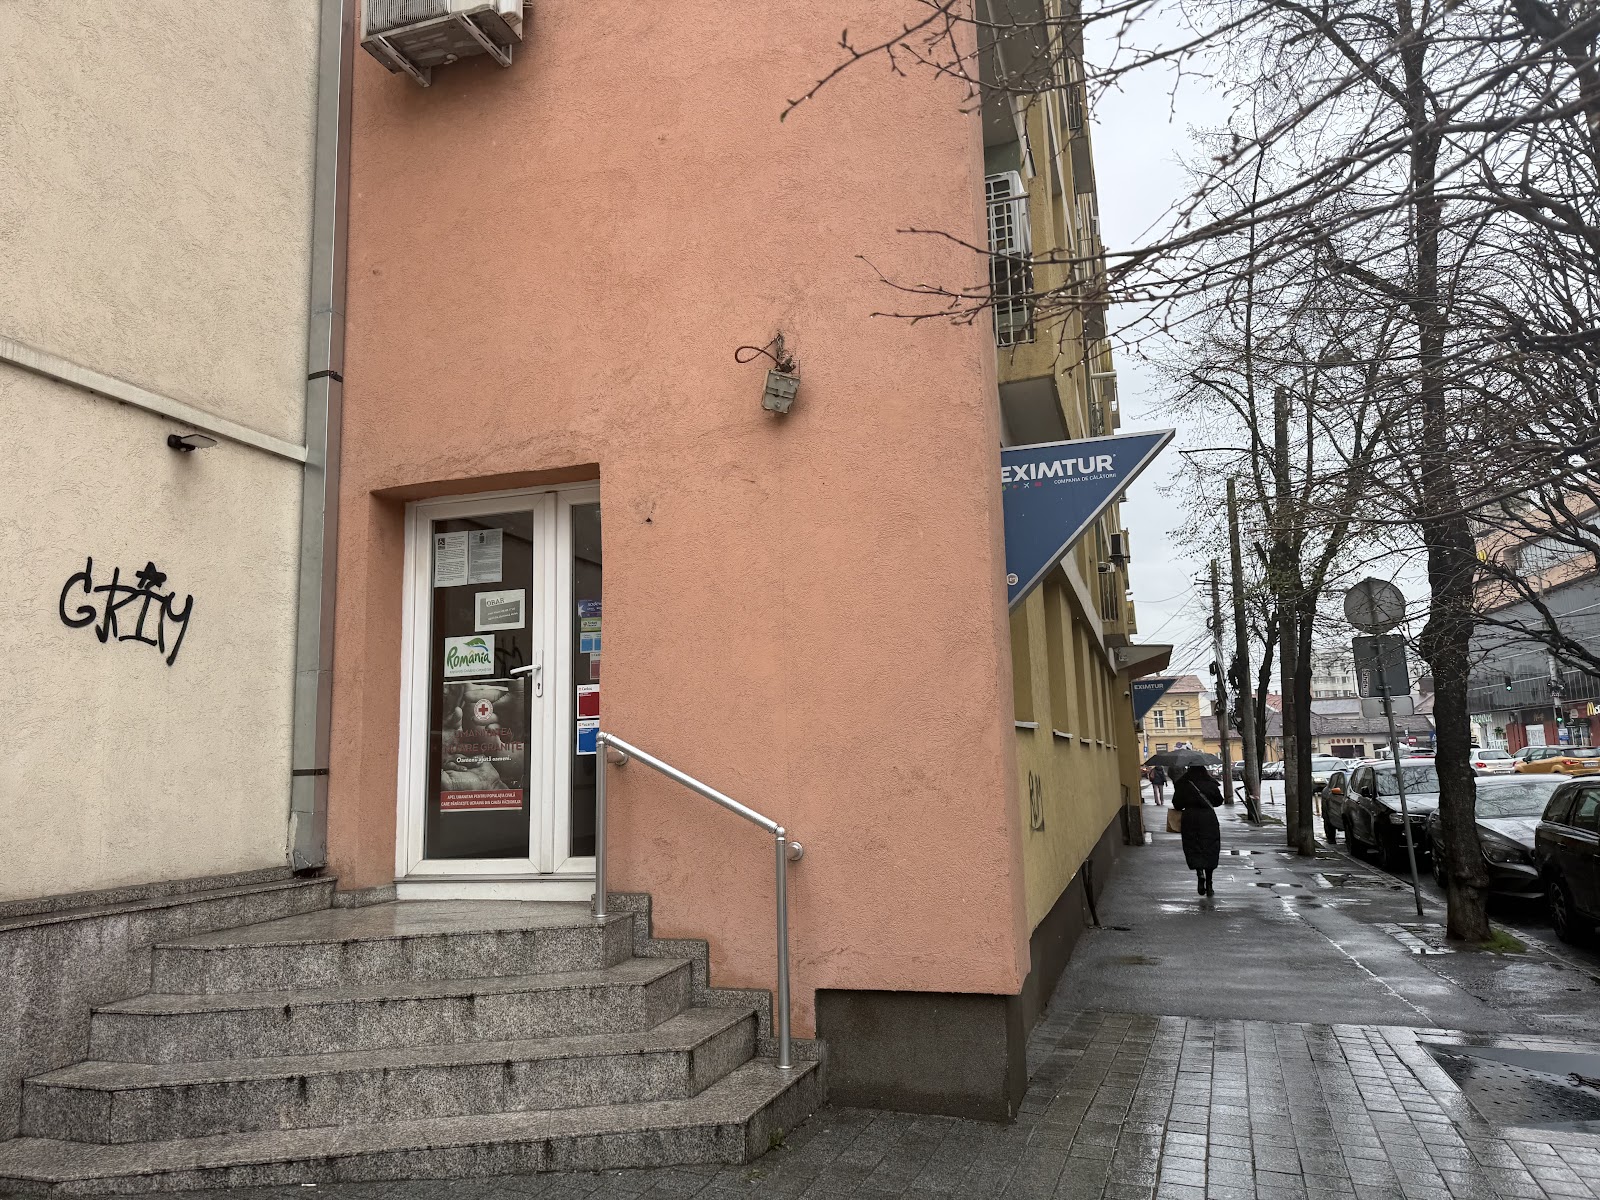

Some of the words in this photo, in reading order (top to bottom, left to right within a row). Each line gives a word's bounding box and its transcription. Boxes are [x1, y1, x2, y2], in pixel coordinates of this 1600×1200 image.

[1001, 454, 1114, 483] EXIMTUR
[1053, 477, 1081, 485] COMPANIA
[454, 728, 513, 739] UMANITATEA
